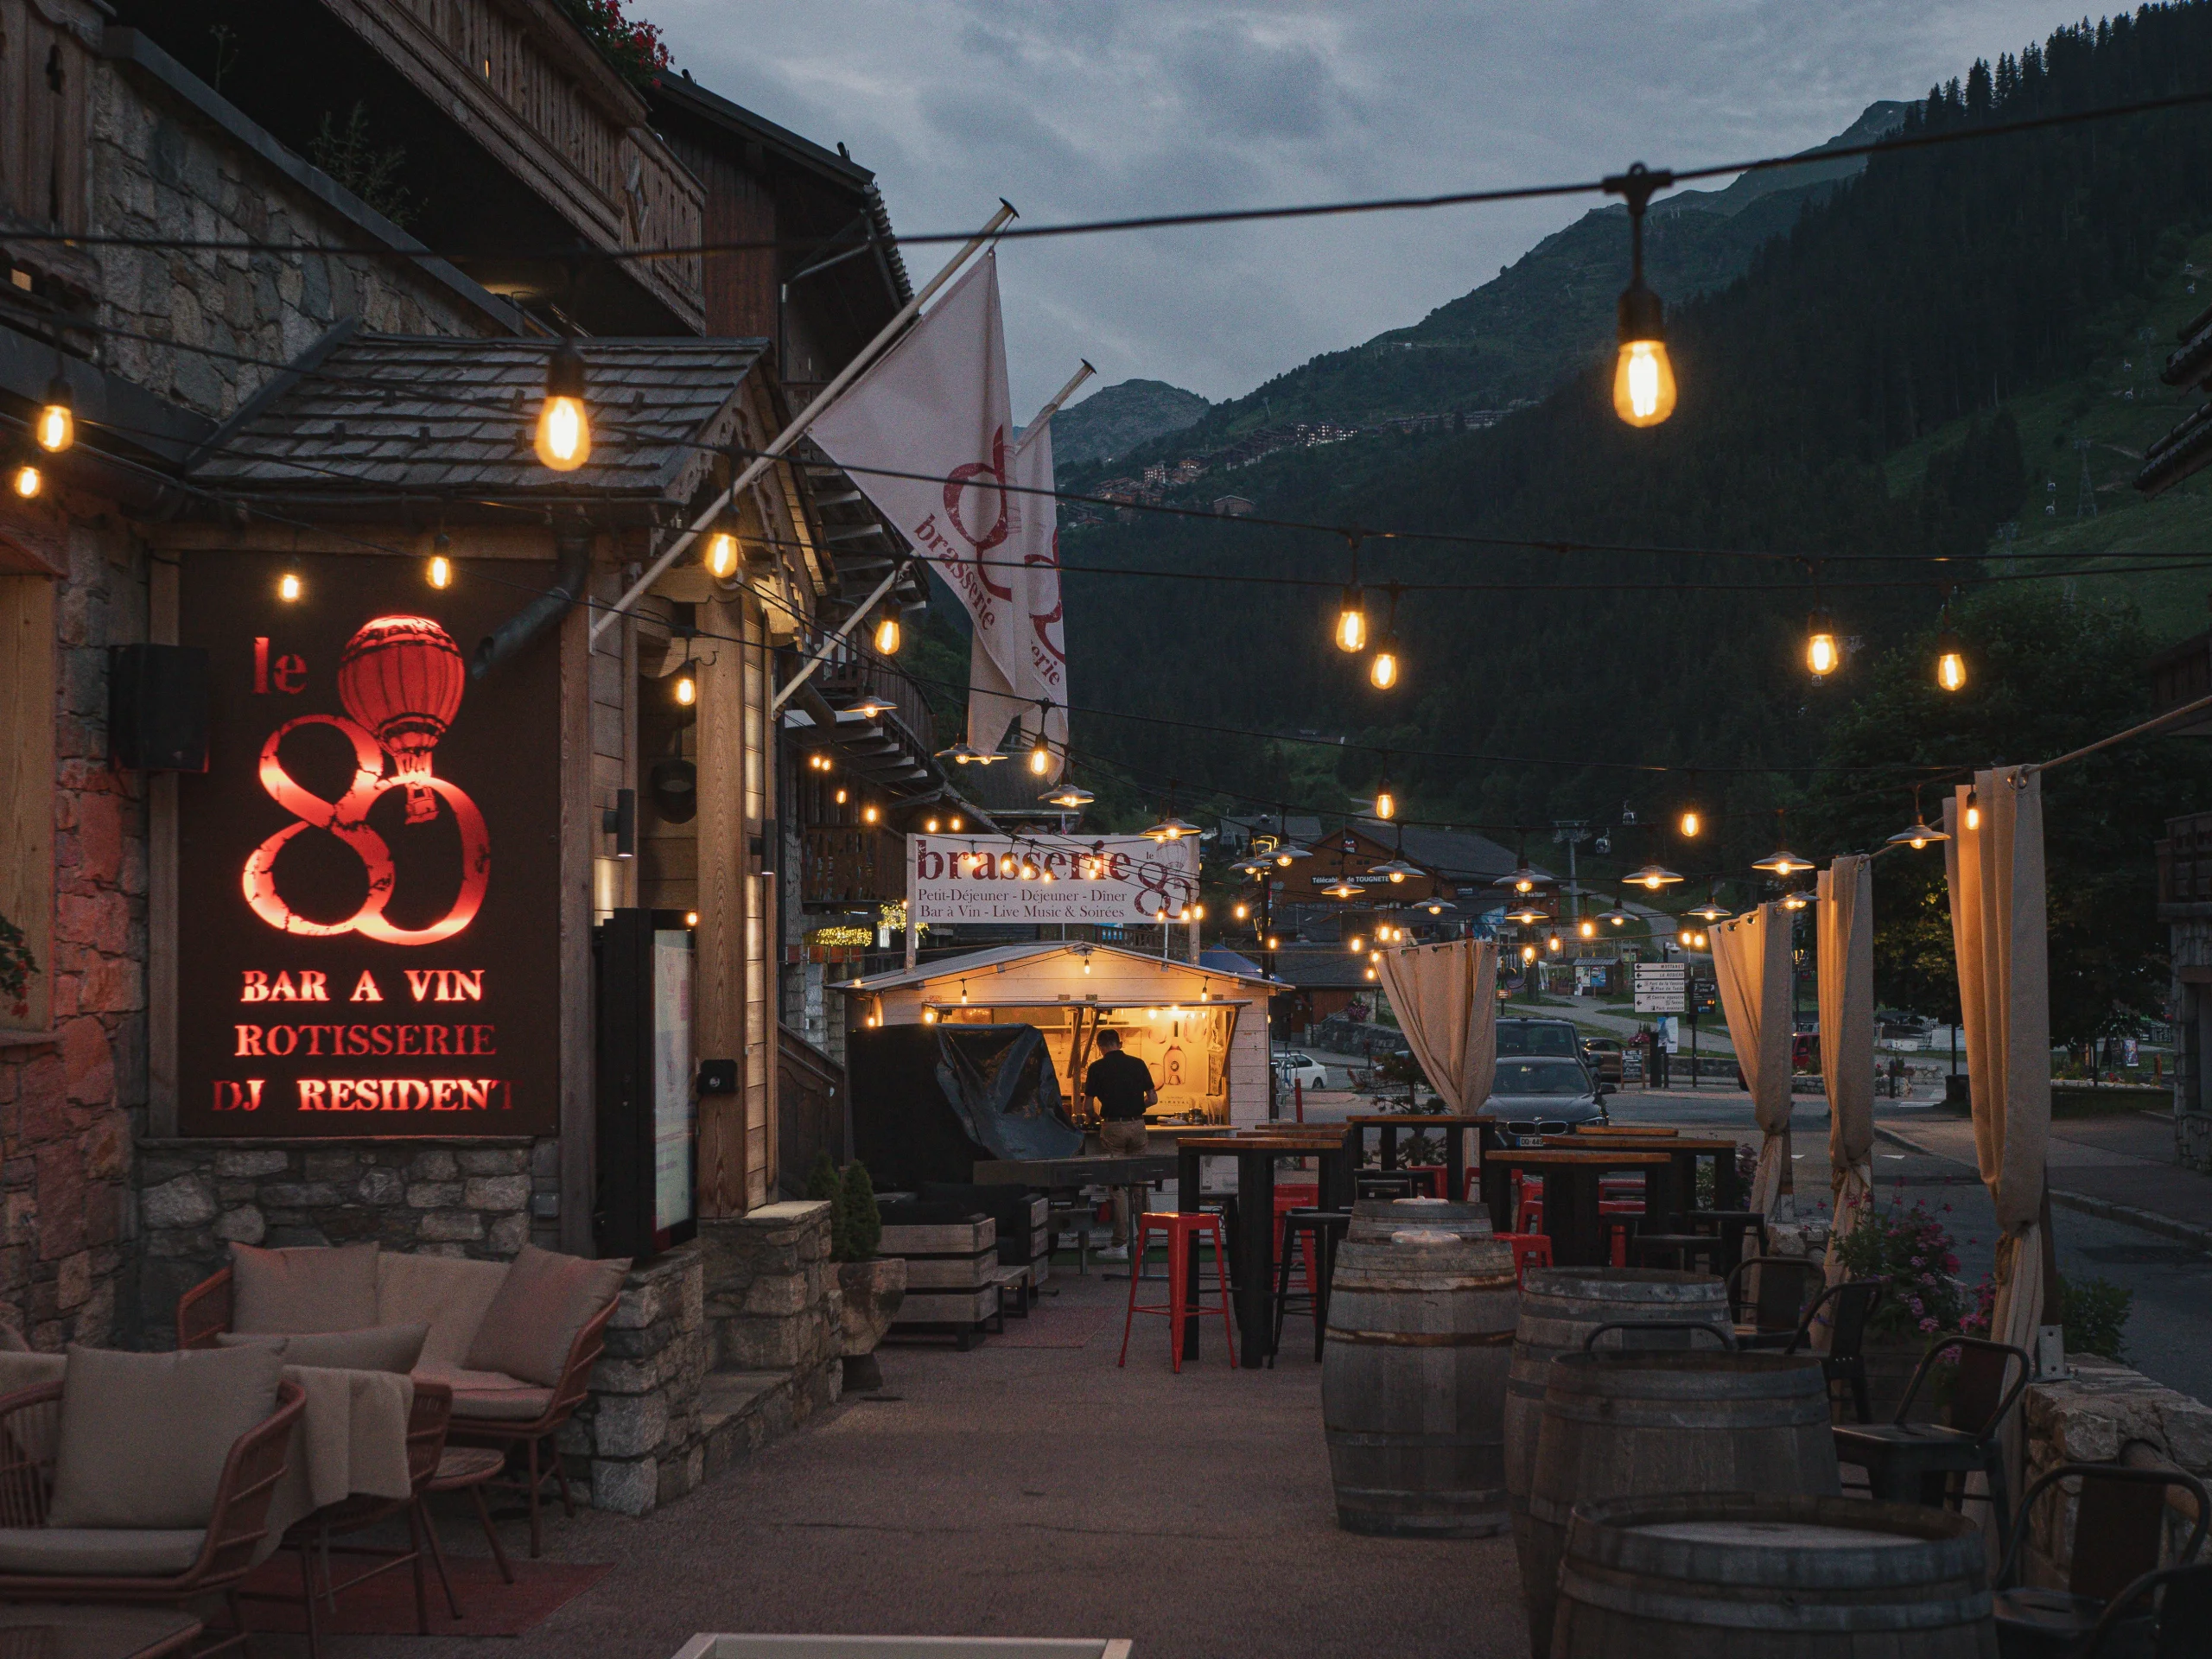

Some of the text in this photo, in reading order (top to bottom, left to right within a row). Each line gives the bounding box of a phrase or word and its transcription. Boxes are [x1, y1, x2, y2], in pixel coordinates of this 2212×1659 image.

[913, 513, 995, 631] brasserie
[252, 637, 308, 695] le
[242, 714, 492, 945] 80
[918, 839, 1131, 880] brasserie
[1146, 850, 1154, 860] le
[918, 888, 1009, 904] Petit-Déjeuner
[1021, 888, 1079, 904] Déjeuner
[1091, 888, 1128, 902] Dîner
[920, 905, 941, 918] Bar
[947, 905, 954, 918] à
[957, 905, 981, 918] Vin
[993, 905, 1020, 918] Live
[1023, 905, 1062, 918] Music
[1065, 905, 1077, 918] &
[1080, 905, 1125, 918] Soirées
[241, 969, 486, 1002] BAR A VIN
[234, 1024, 498, 1057] ROTISSERIE
[212, 1078, 524, 1113] DJ RESIDENT
